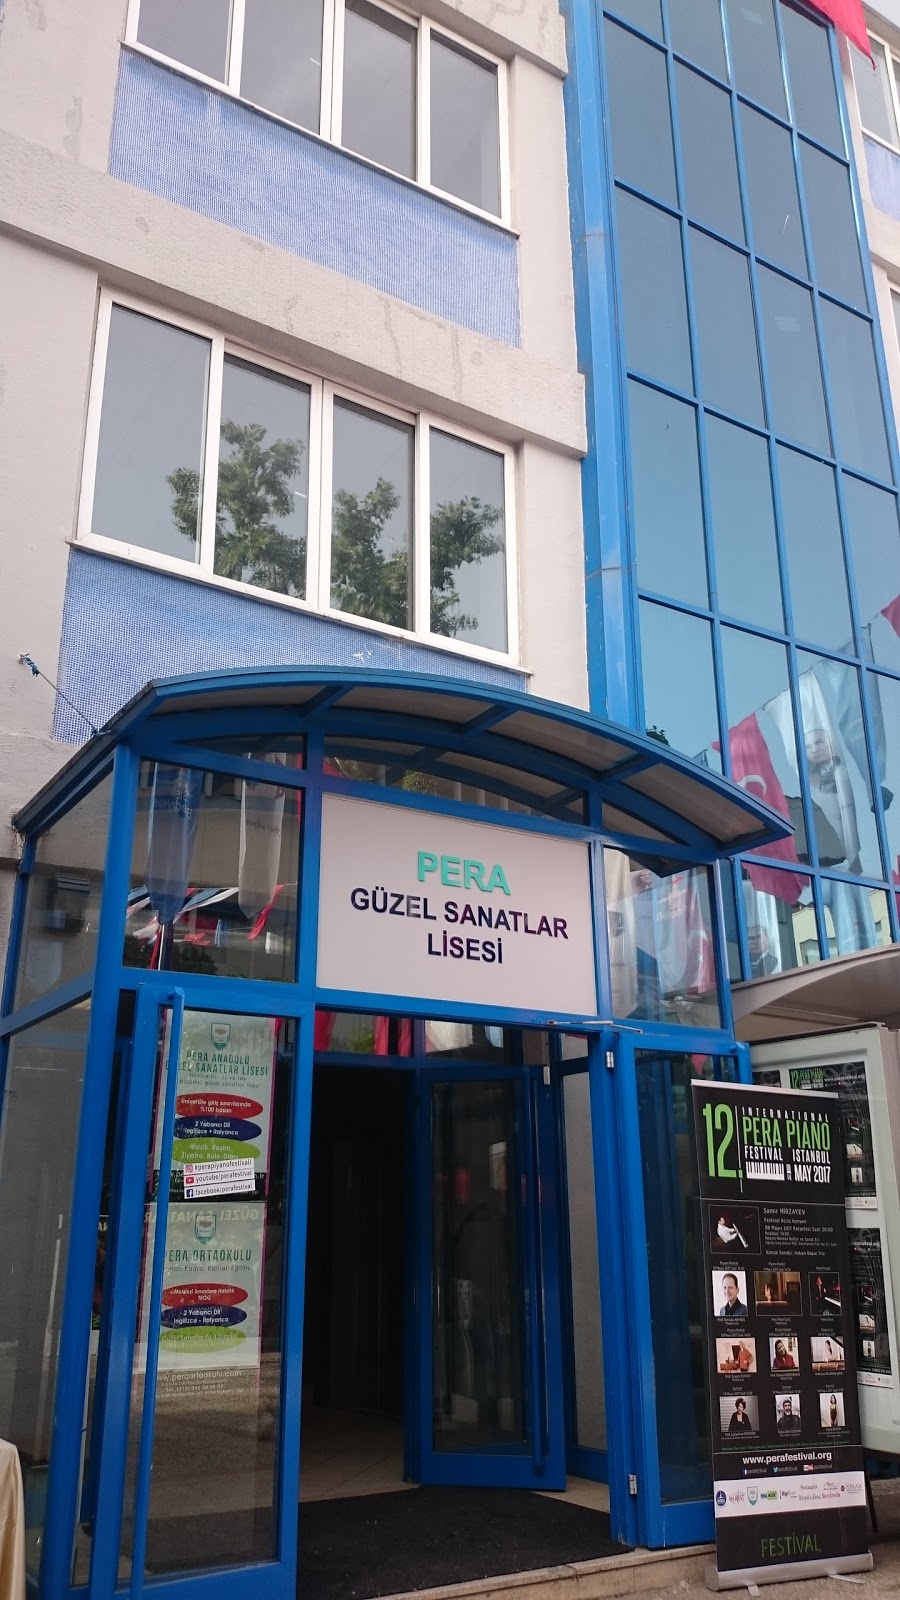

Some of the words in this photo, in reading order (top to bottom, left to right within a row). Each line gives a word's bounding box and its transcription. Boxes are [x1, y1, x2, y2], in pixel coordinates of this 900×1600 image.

[417, 850, 512, 896] PERA
[350, 885, 437, 921] GÜZEL
[443, 900, 569, 940] SANATLAR
[427, 929, 503, 964] LİSESİ
[186, 1051, 208, 1062] PERA
[211, 1053, 250, 1065] ANADOLU
[195, 1062, 239, 1075] SANATLAR
[242, 1064, 268, 1077] LİSESİ
[741, 1106, 830, 1123] INTERNATIONAL
[702, 1103, 743, 1179] 12.
[742, 1116, 783, 1148] PERA
[785, 1119, 831, 1151] PIANO
[744, 1145, 783, 1161] FESTIVAL
[792, 1148, 831, 1165] ISTANBUL
[195, 1170, 253, 1183] youtube/perafestival
[793, 1164, 812, 1183] MAY
[813, 1165, 831, 1184] 2017
[195, 1183, 253, 1196] facebook/perafestival
[192, 1248, 252, 1262] ORTAOKULU
[742, 1451, 832, 1465] www.perafestival.org
[760, 1532, 822, 1558] FESTİVAL
